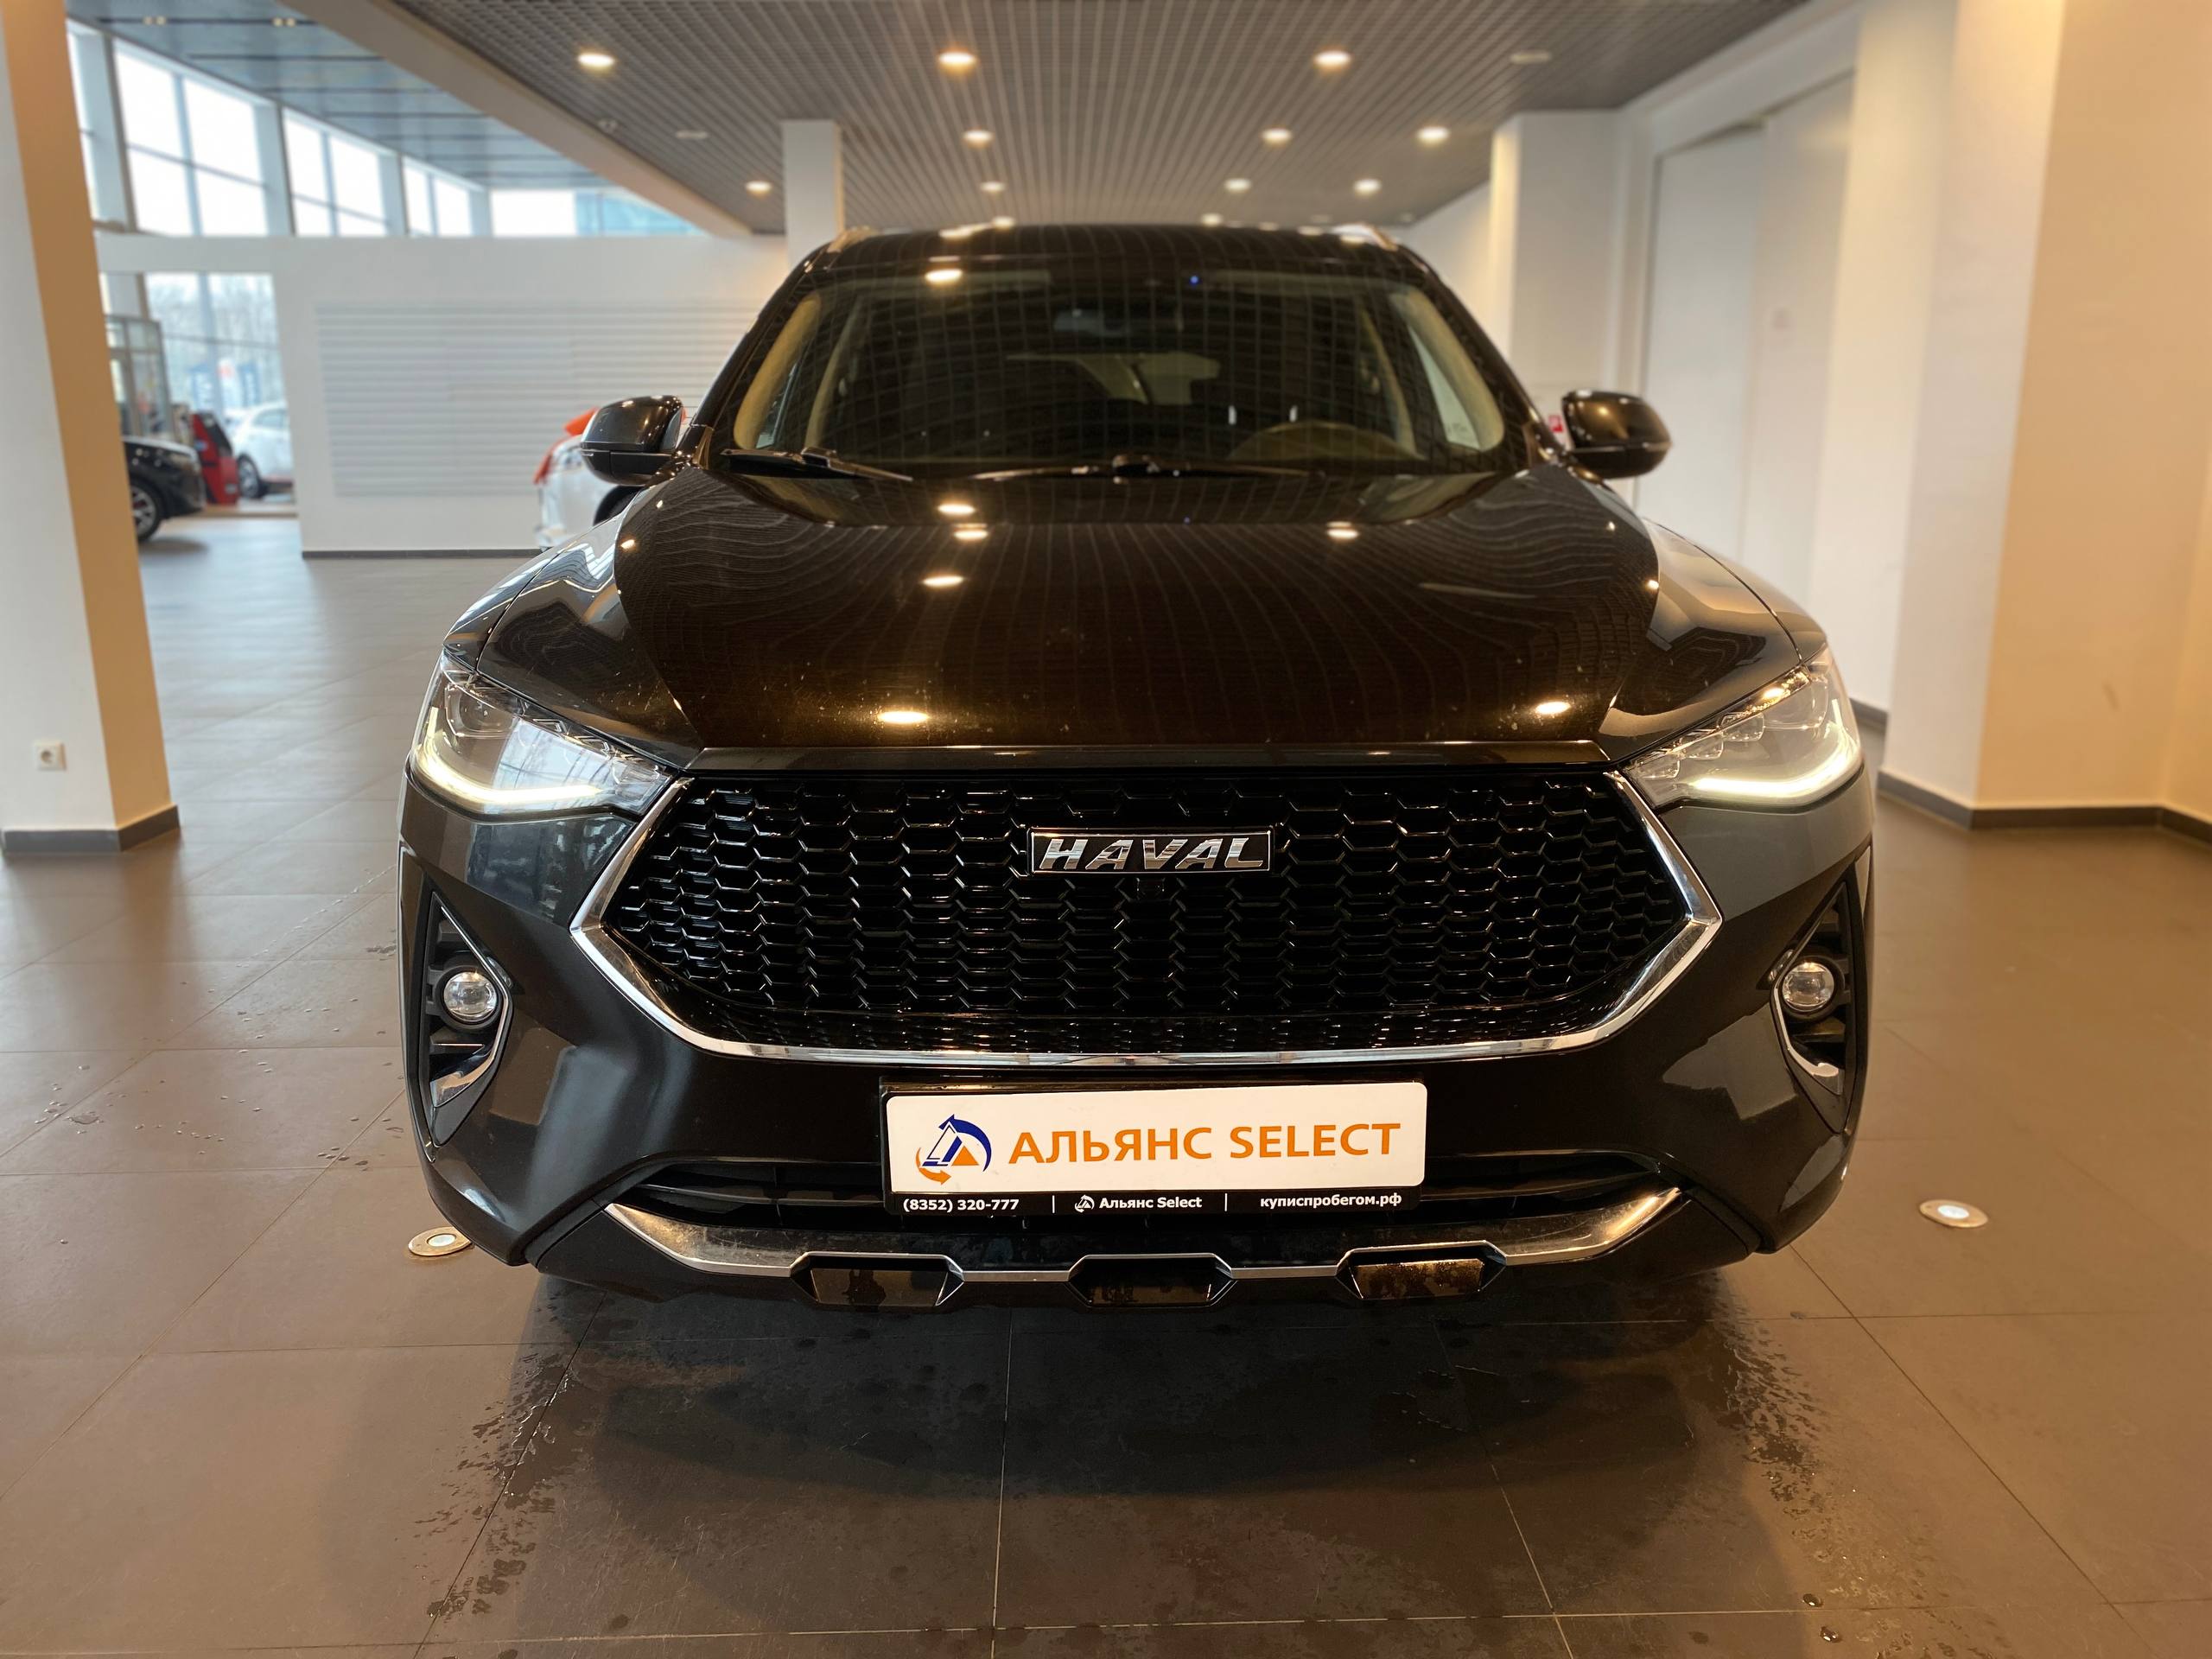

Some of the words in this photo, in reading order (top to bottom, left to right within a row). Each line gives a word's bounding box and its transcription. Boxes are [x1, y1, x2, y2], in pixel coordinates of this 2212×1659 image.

[1039, 838, 1263, 870] HAVAL
[1008, 1127, 1212, 1164] АЛЬЯНС
[1230, 1123, 1401, 1159] SELECT
[903, 1198, 953, 1212] (8352)
[957, 1198, 1020, 1211] 320-777
[1099, 1198, 1154, 1209] Альянс
[1157, 1196, 1202, 1208] Select
[1260, 1192, 1402, 1210] куписпробегом.рф
